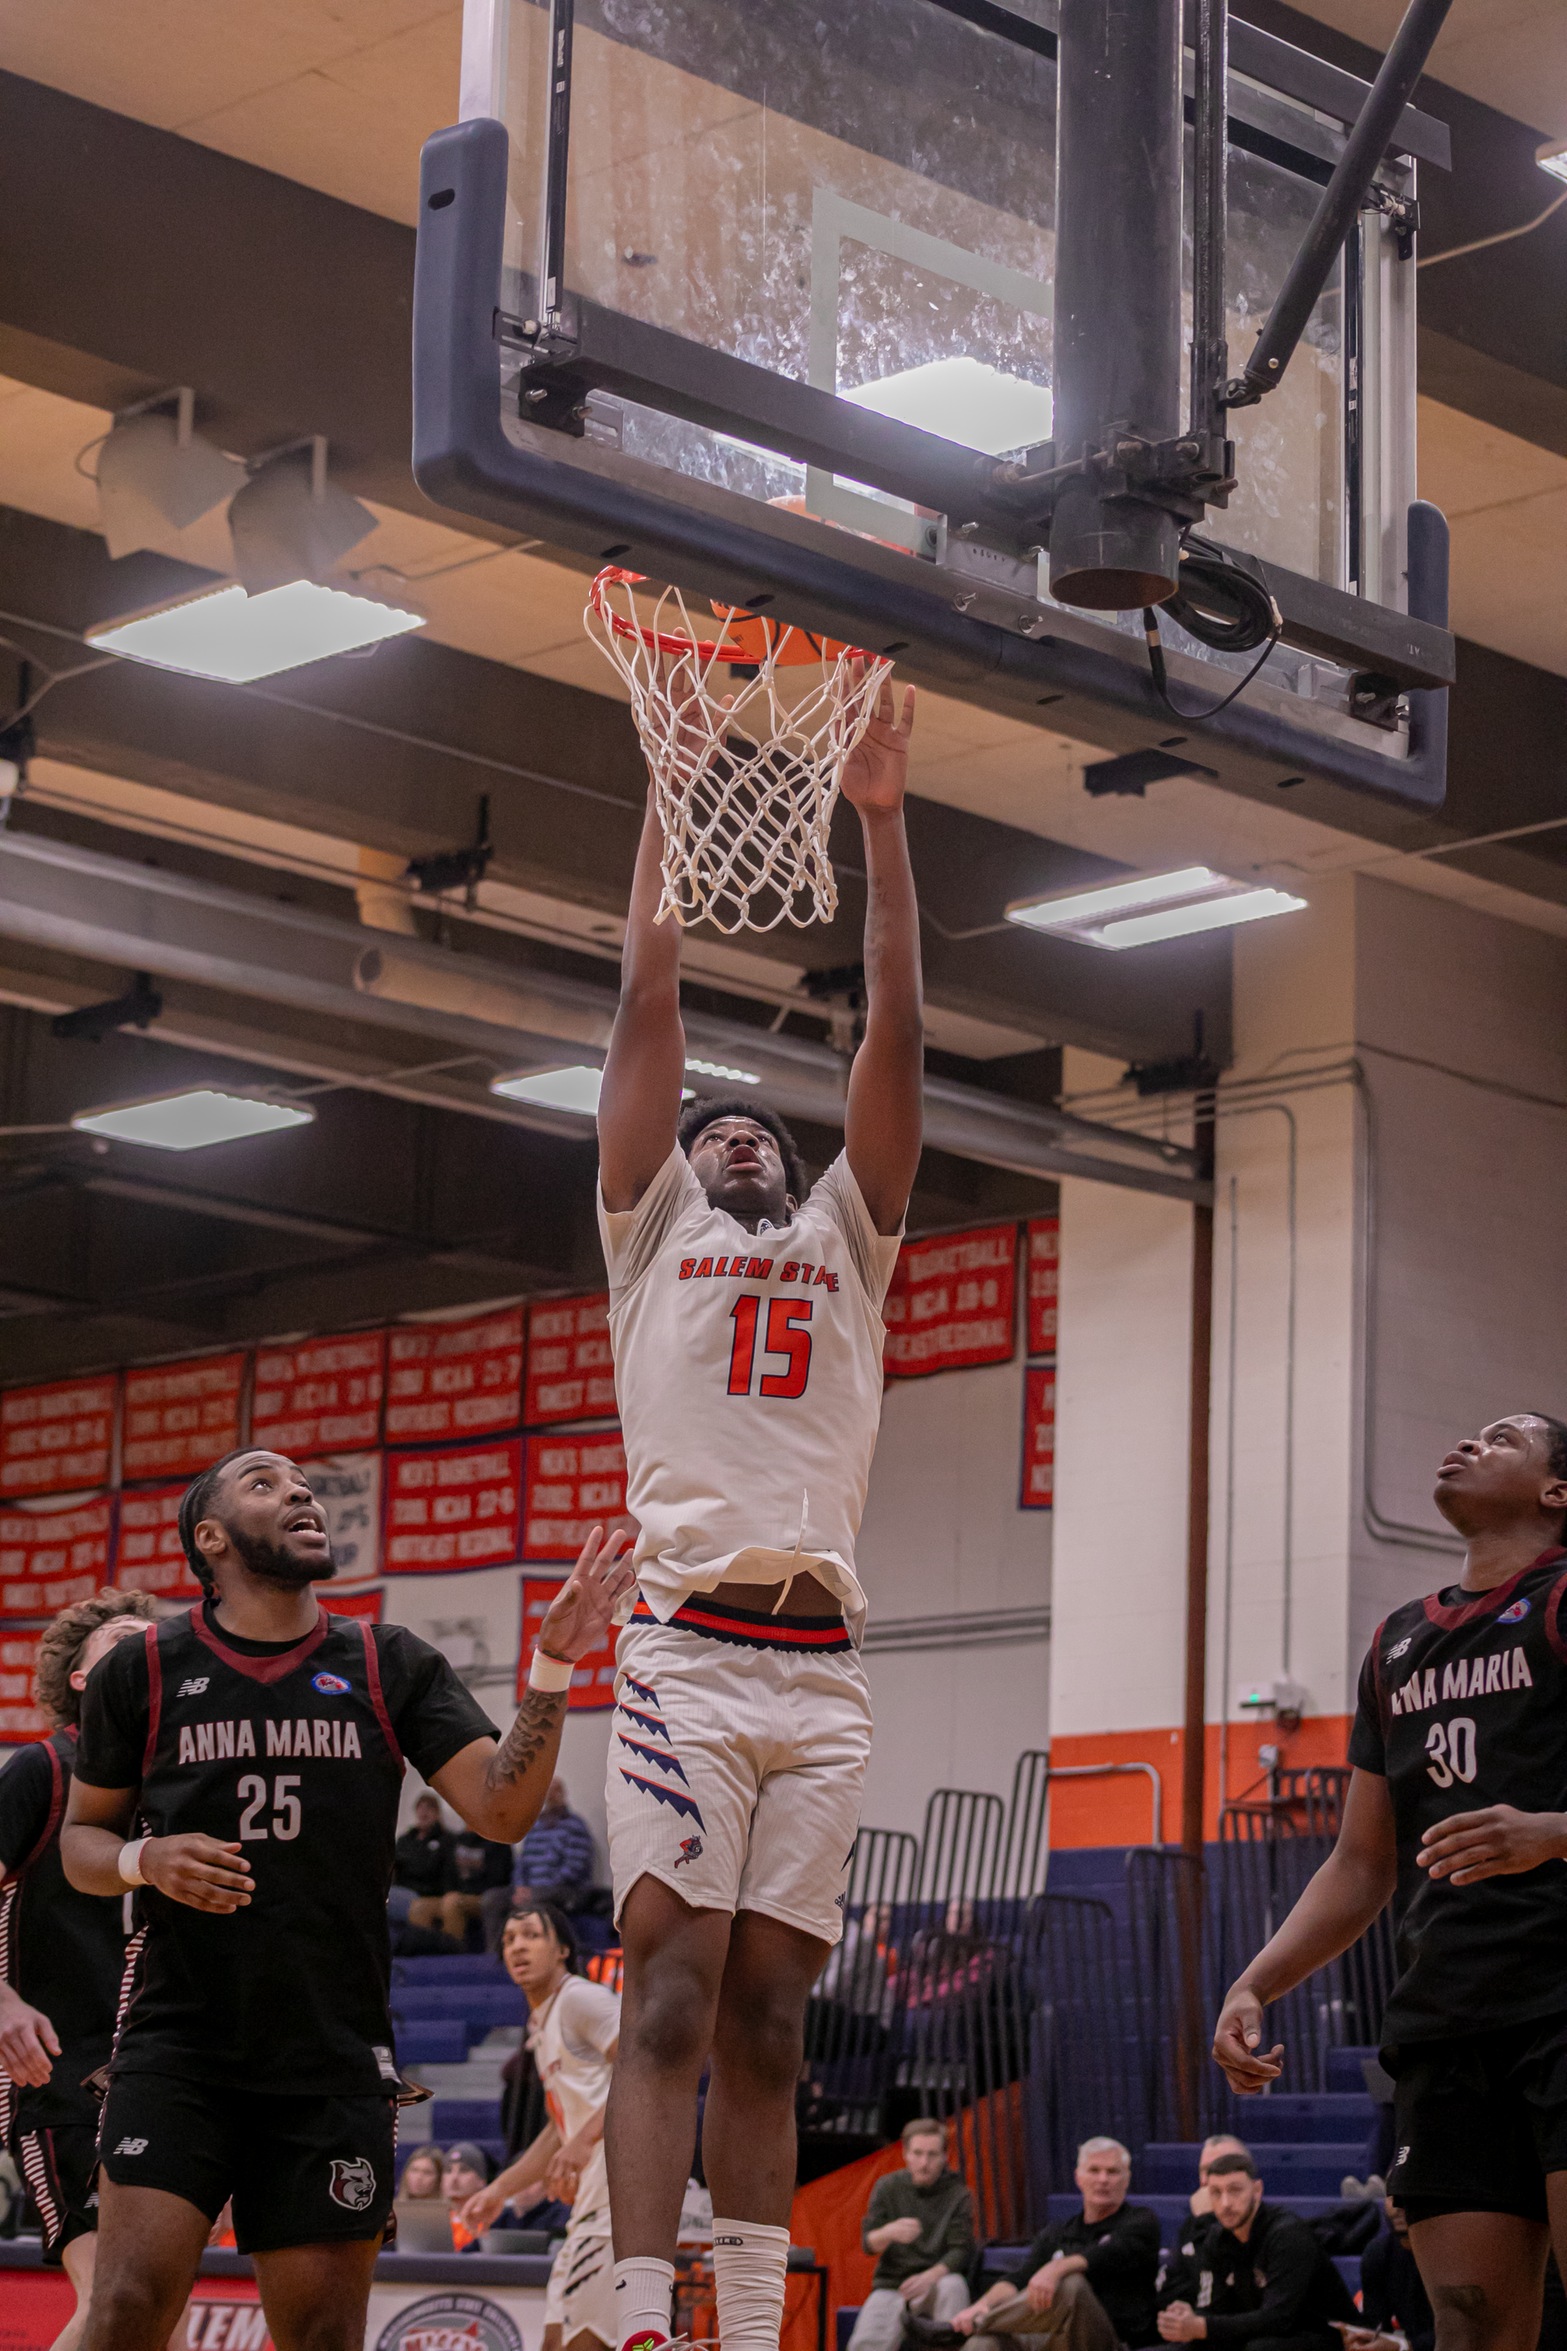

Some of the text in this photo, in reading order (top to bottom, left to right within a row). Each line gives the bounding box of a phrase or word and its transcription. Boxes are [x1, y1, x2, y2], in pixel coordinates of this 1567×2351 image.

[678, 1256, 774, 1280] SALEM
[727, 1294, 814, 1399] 15
[1442, 1646, 1533, 1700] MARIA
[178, 1719, 362, 1765] ANNA MARIA
[1424, 1716, 1478, 1788] 30
[237, 1774, 302, 1841] 25
